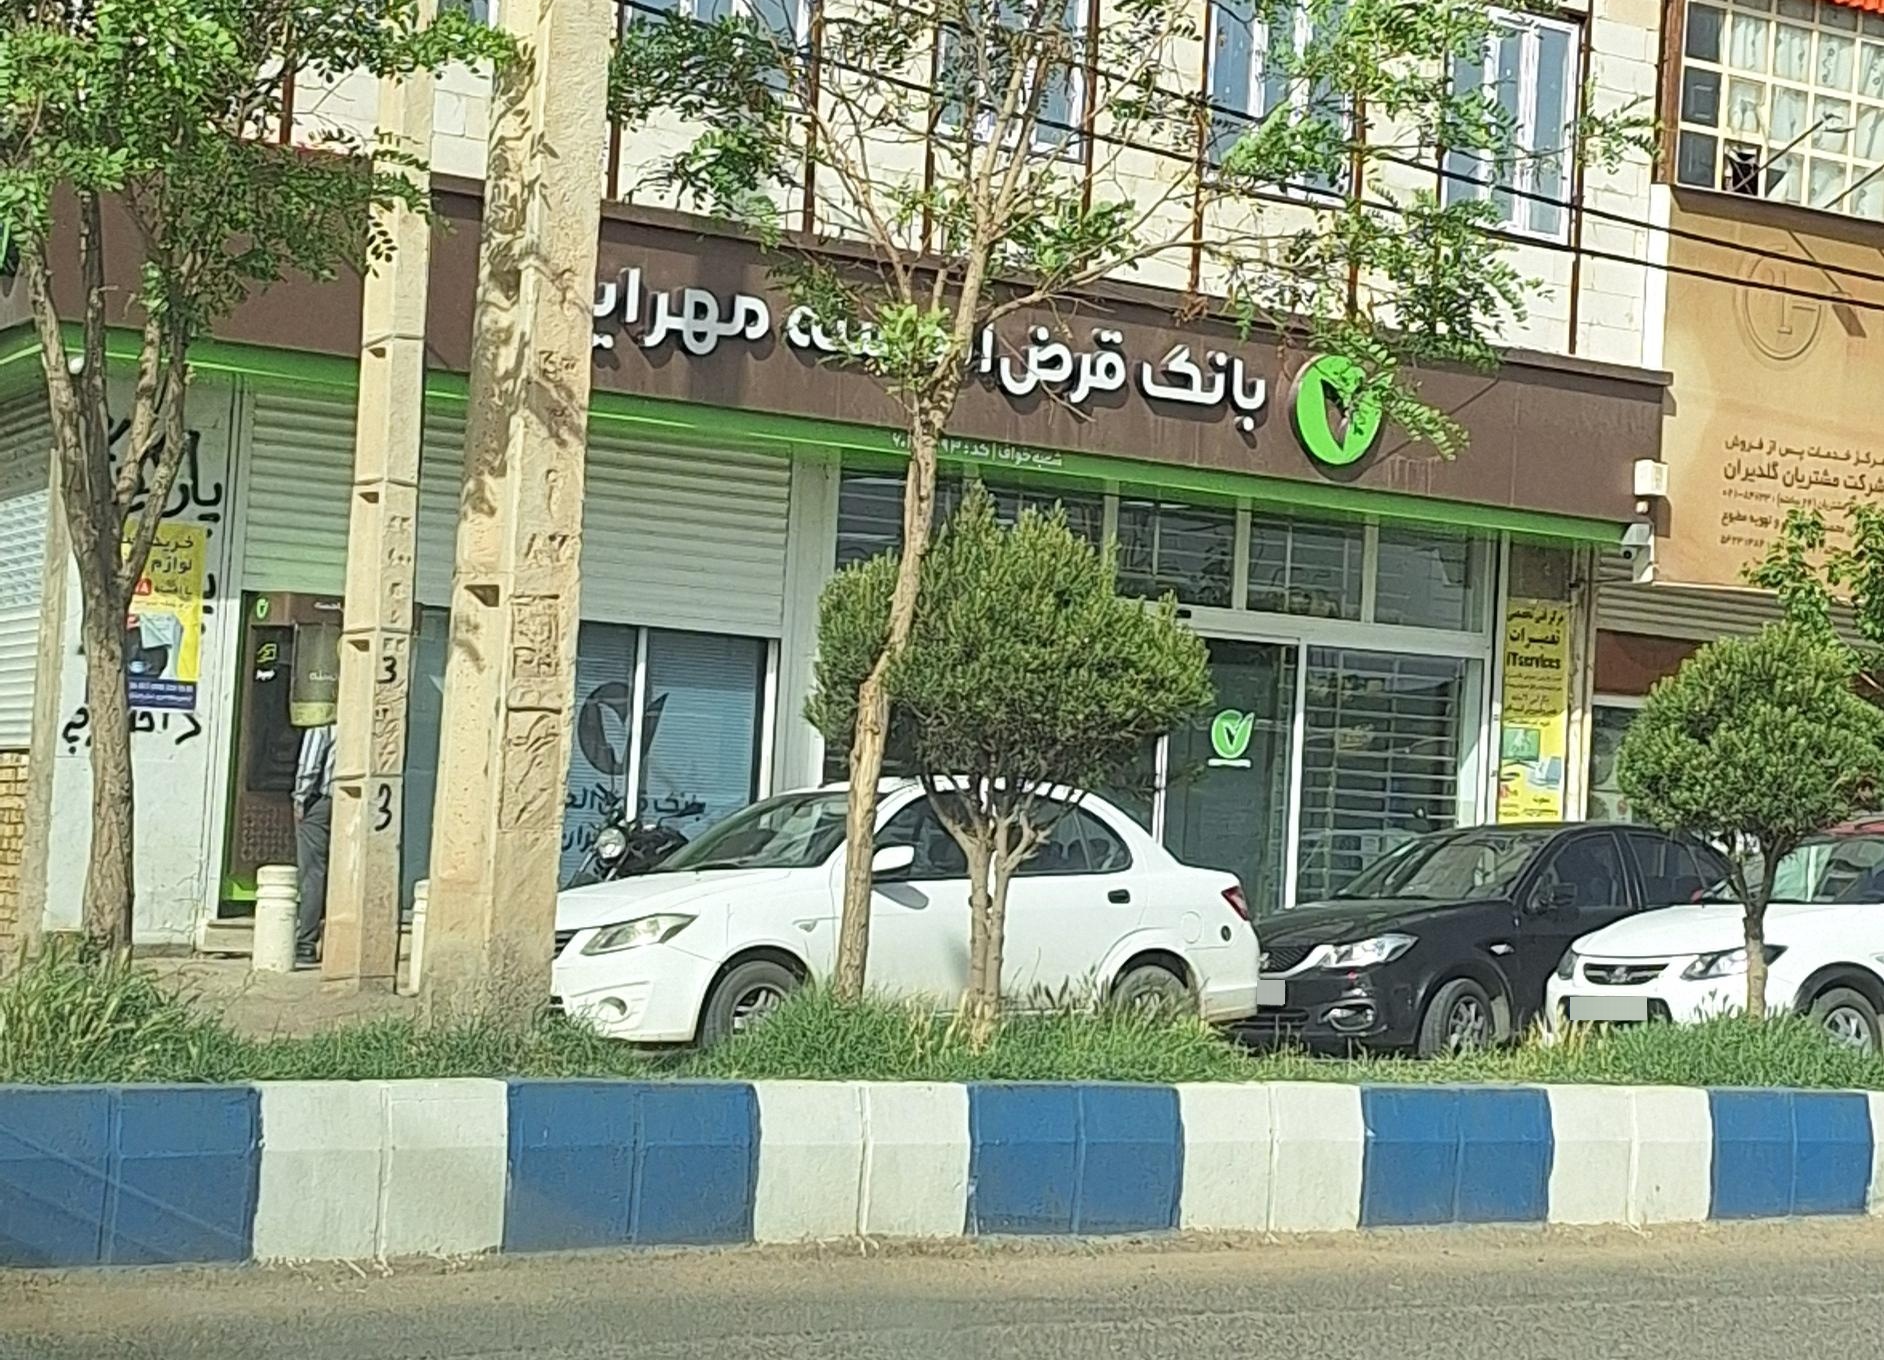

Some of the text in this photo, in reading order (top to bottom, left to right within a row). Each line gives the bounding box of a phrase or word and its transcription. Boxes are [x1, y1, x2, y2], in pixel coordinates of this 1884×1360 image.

[643, 288, 770, 355] مهر
[1000, 326, 1127, 404] قرض
[1140, 343, 1267, 432] بانک
[998, 444, 1031, 465] خواف
[1032, 451, 1062, 468] شعبه
[1725, 435, 1884, 468] رکز خدمات پس از فروش
[1723, 458, 1884, 497] شرکت مشتریان گلدیران
[151, 556, 192, 574] لوازم
